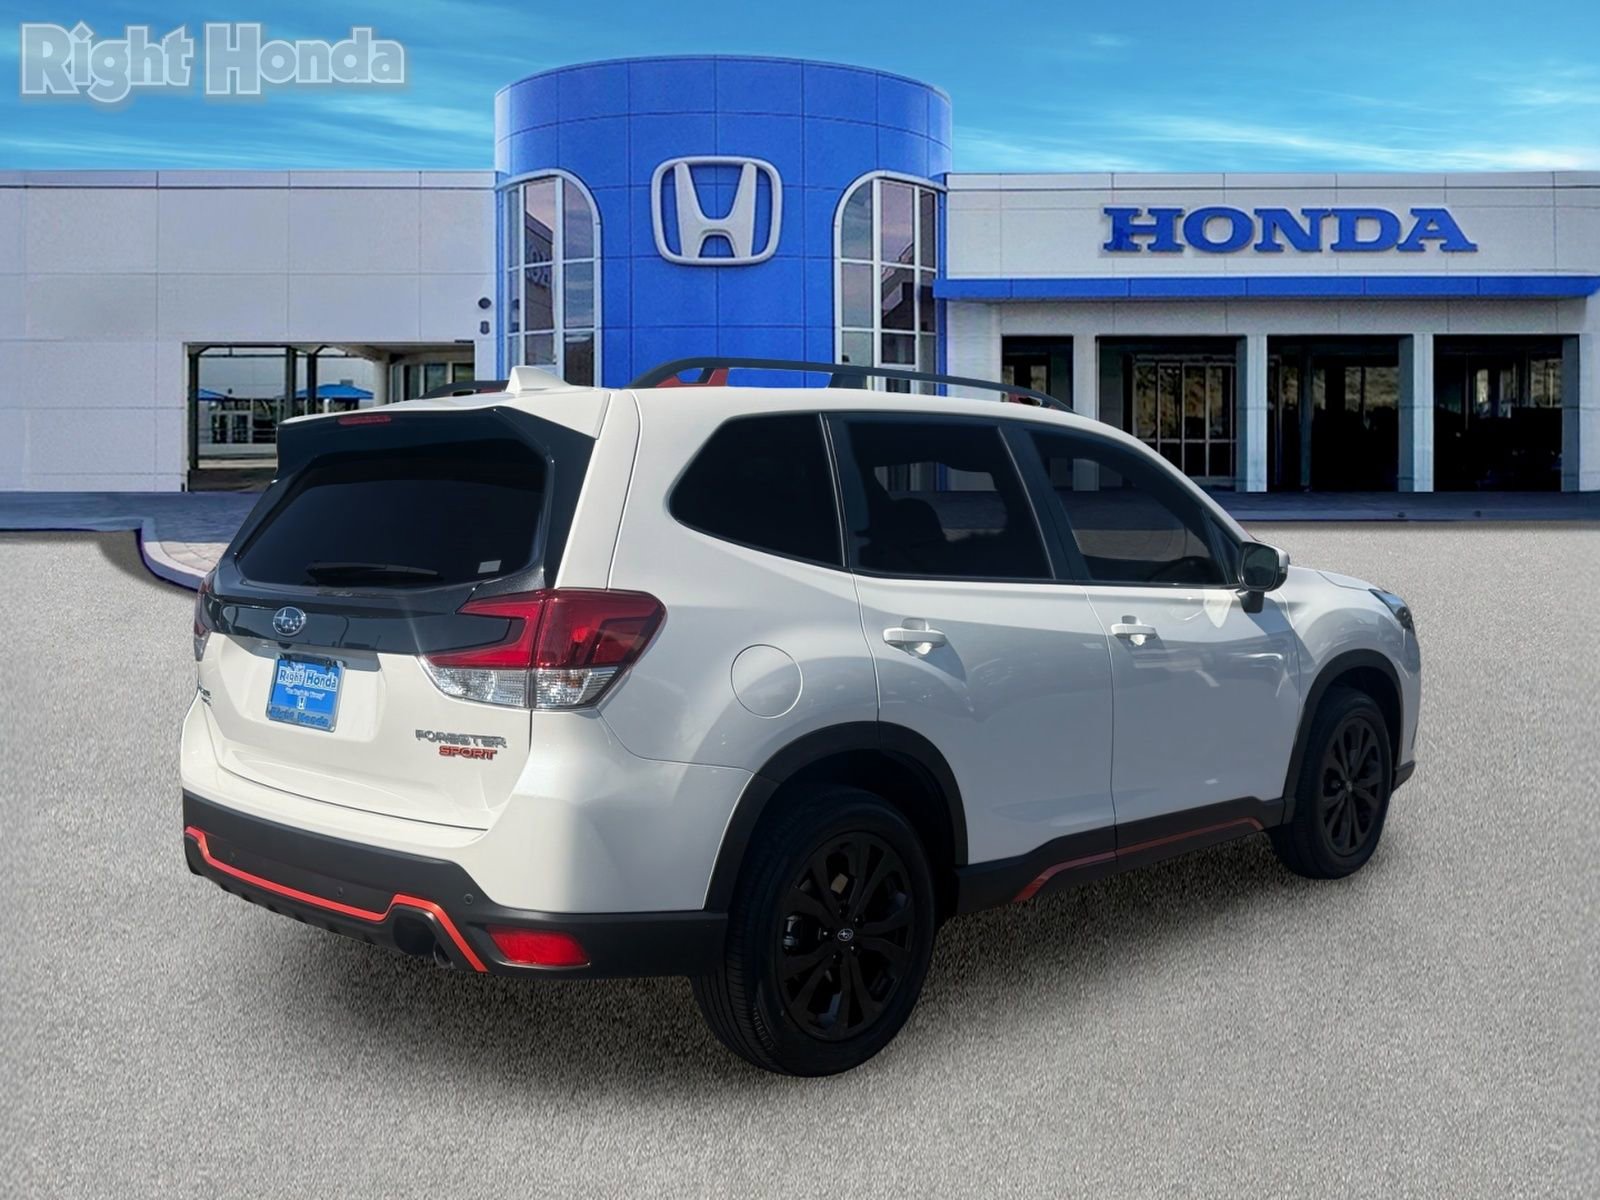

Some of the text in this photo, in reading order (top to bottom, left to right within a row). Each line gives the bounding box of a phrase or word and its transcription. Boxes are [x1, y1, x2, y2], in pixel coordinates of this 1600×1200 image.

[1103, 206, 1478, 253] HONDA
[278, 666, 338, 690] Right Honda
[415, 729, 507, 748] FORESTER
[439, 745, 498, 760] SPORT
